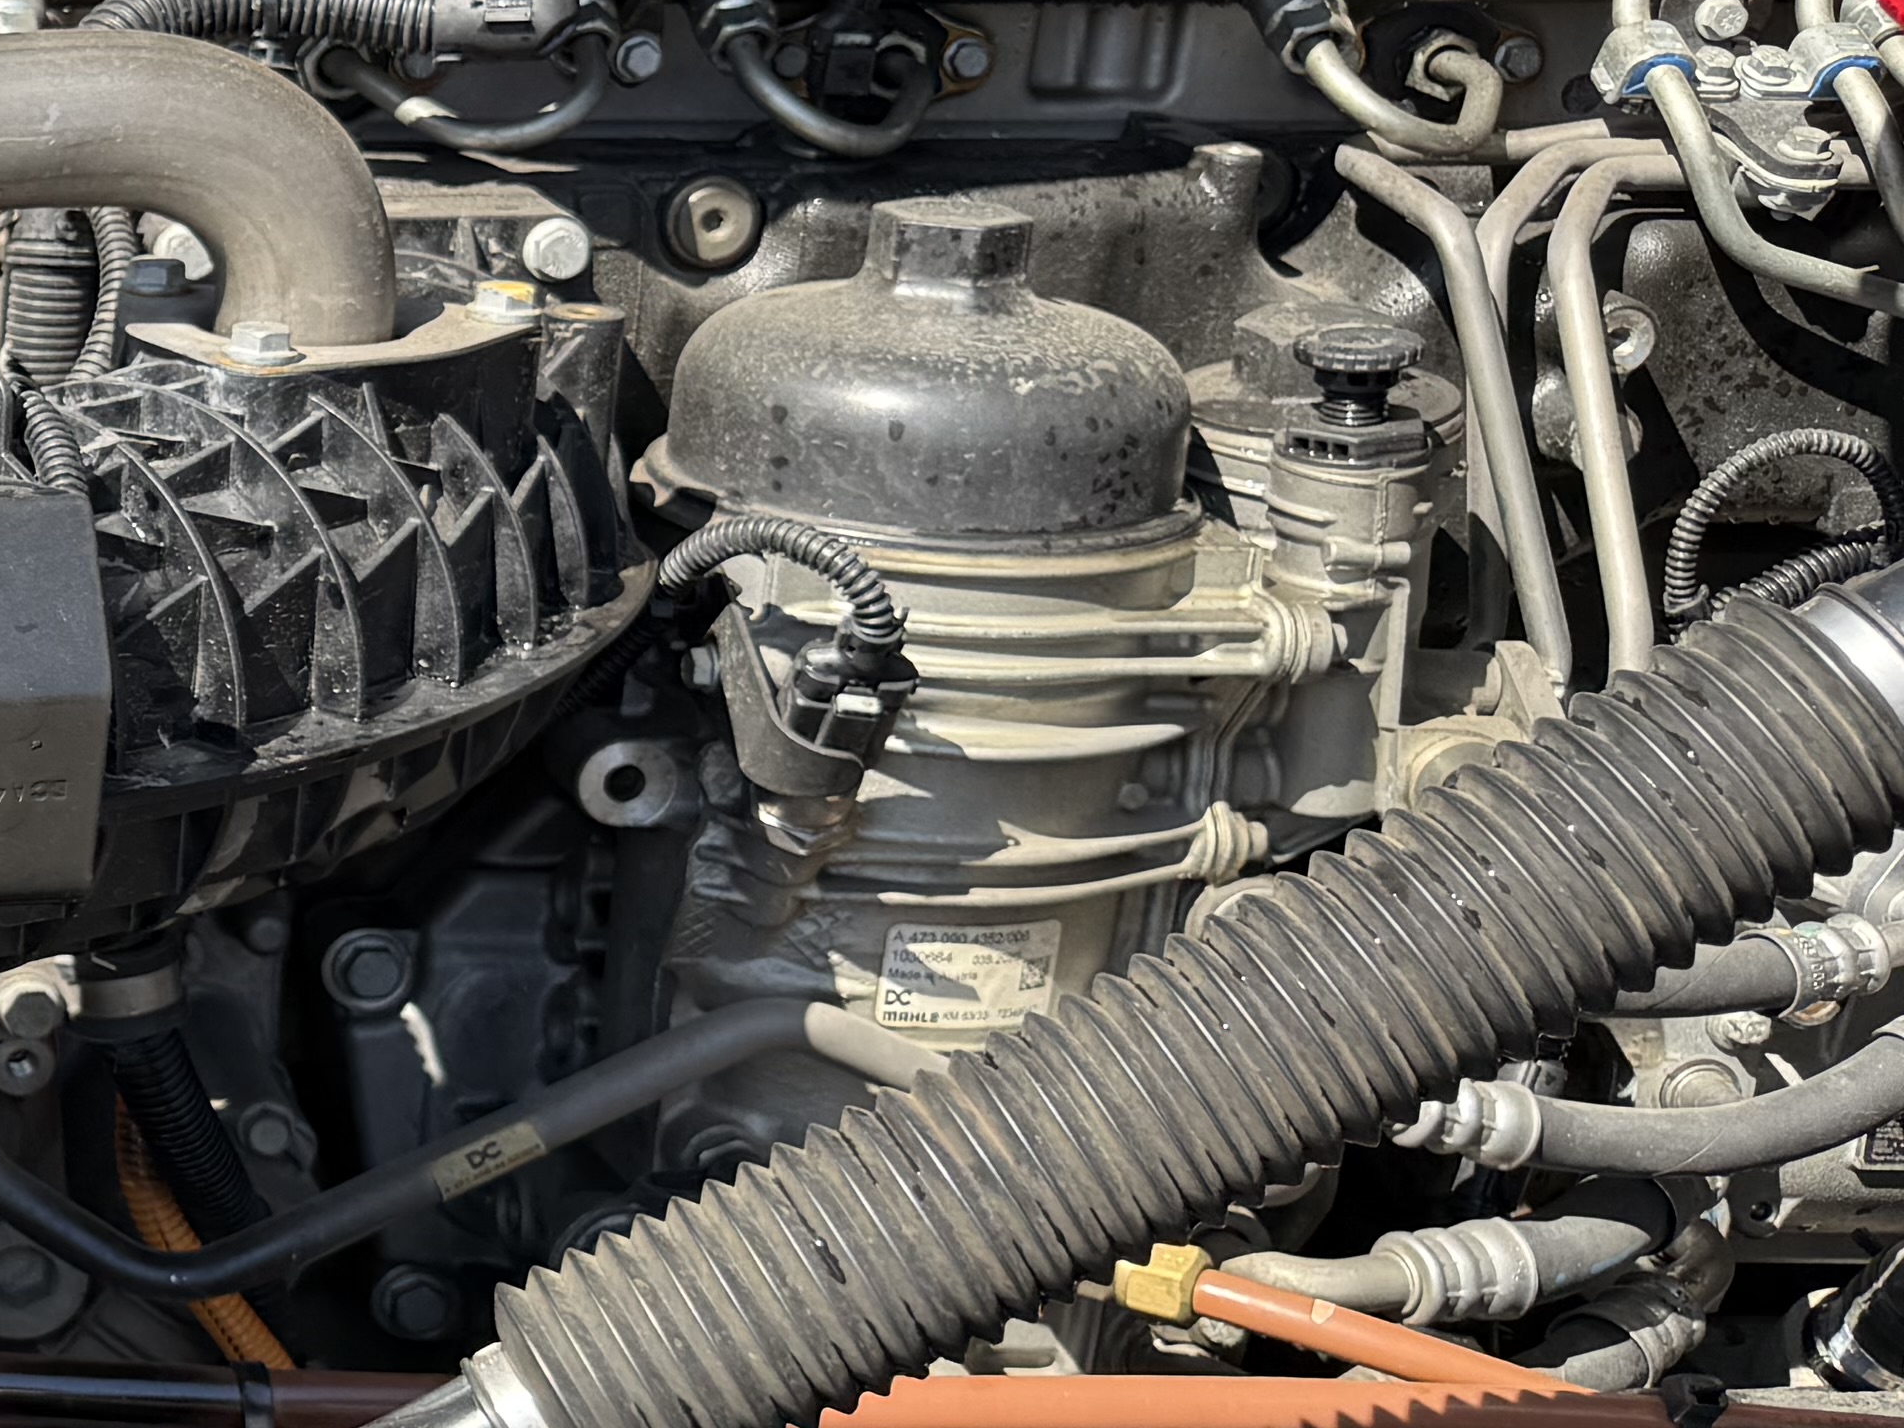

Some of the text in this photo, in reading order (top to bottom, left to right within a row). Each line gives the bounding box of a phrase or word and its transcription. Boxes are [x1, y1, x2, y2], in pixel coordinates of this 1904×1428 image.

[885, 990, 911, 1005] DC
[883, 1011, 939, 1023] MAHLE
[465, 1140, 502, 1169] DC
